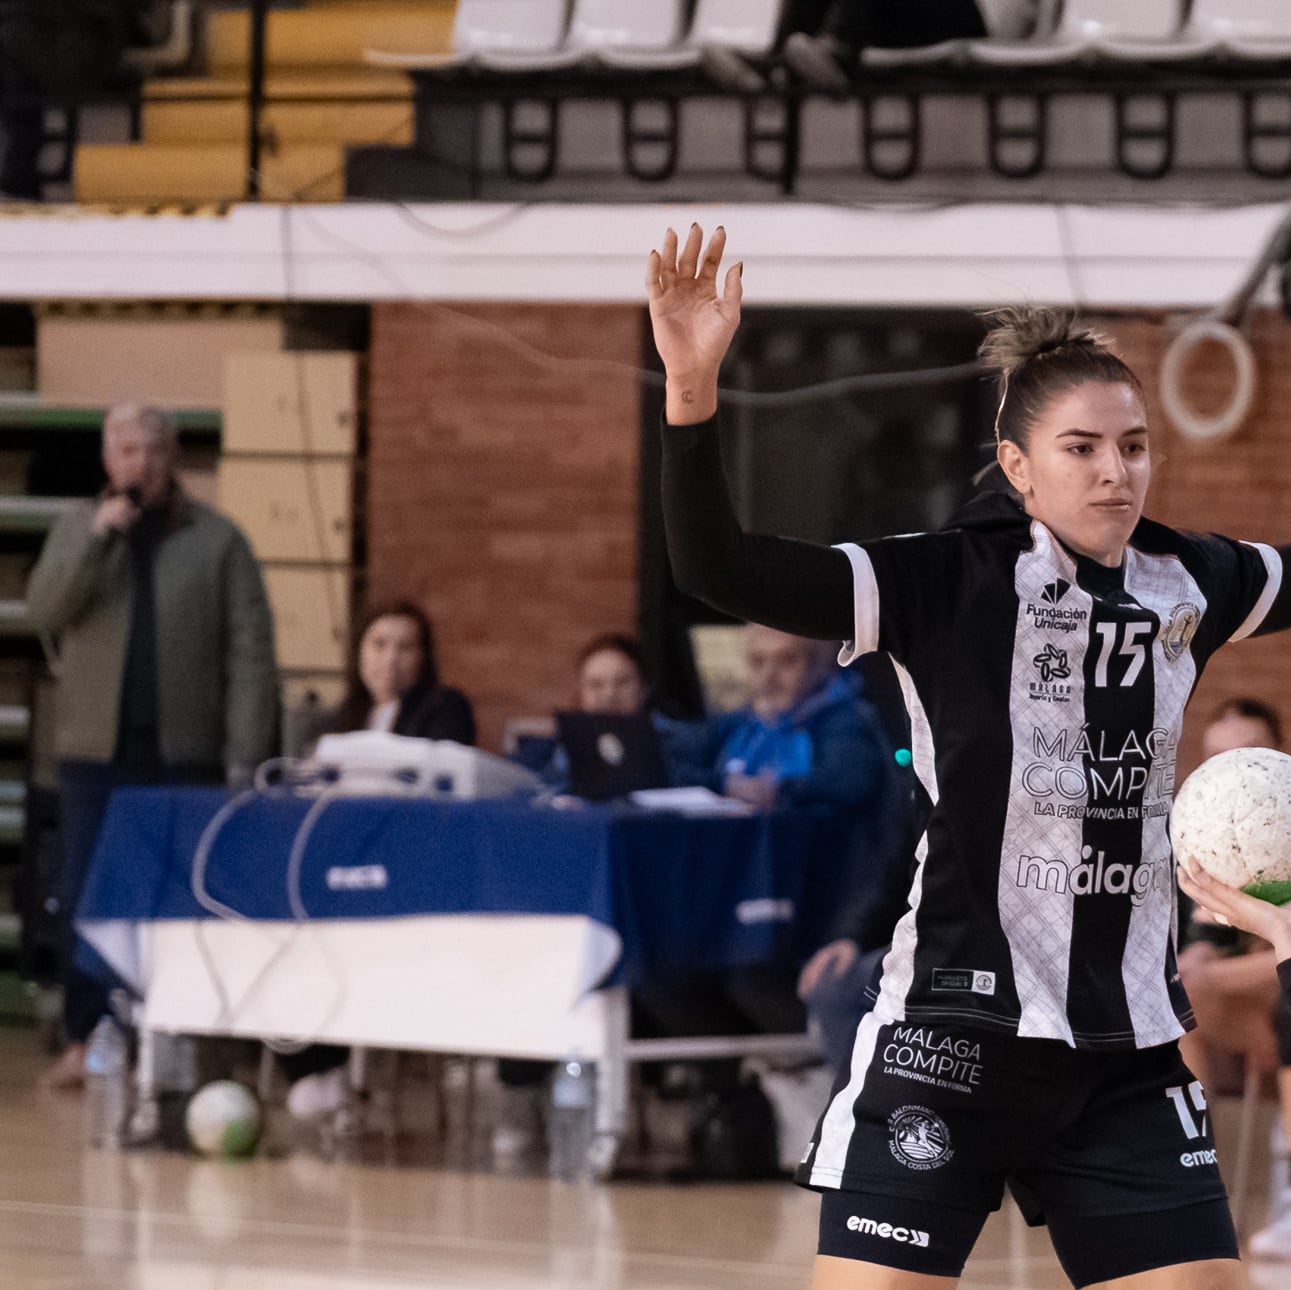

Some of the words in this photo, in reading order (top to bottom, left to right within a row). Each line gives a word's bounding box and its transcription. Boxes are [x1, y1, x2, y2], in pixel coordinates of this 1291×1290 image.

[1026, 603, 1087, 620] Fundación
[1034, 617, 1078, 633] Unicaja
[1095, 622, 1152, 688] 15
[1034, 802, 1055, 816] LA
[1057, 804, 1124, 819] PROVINCIA
[1127, 807, 1139, 819] EN
[883, 1044, 984, 1085] COMPITE
[883, 1066, 892, 1075] LA
[893, 1067, 936, 1085] PROVINCIA
[937, 1079, 947, 1088] EN
